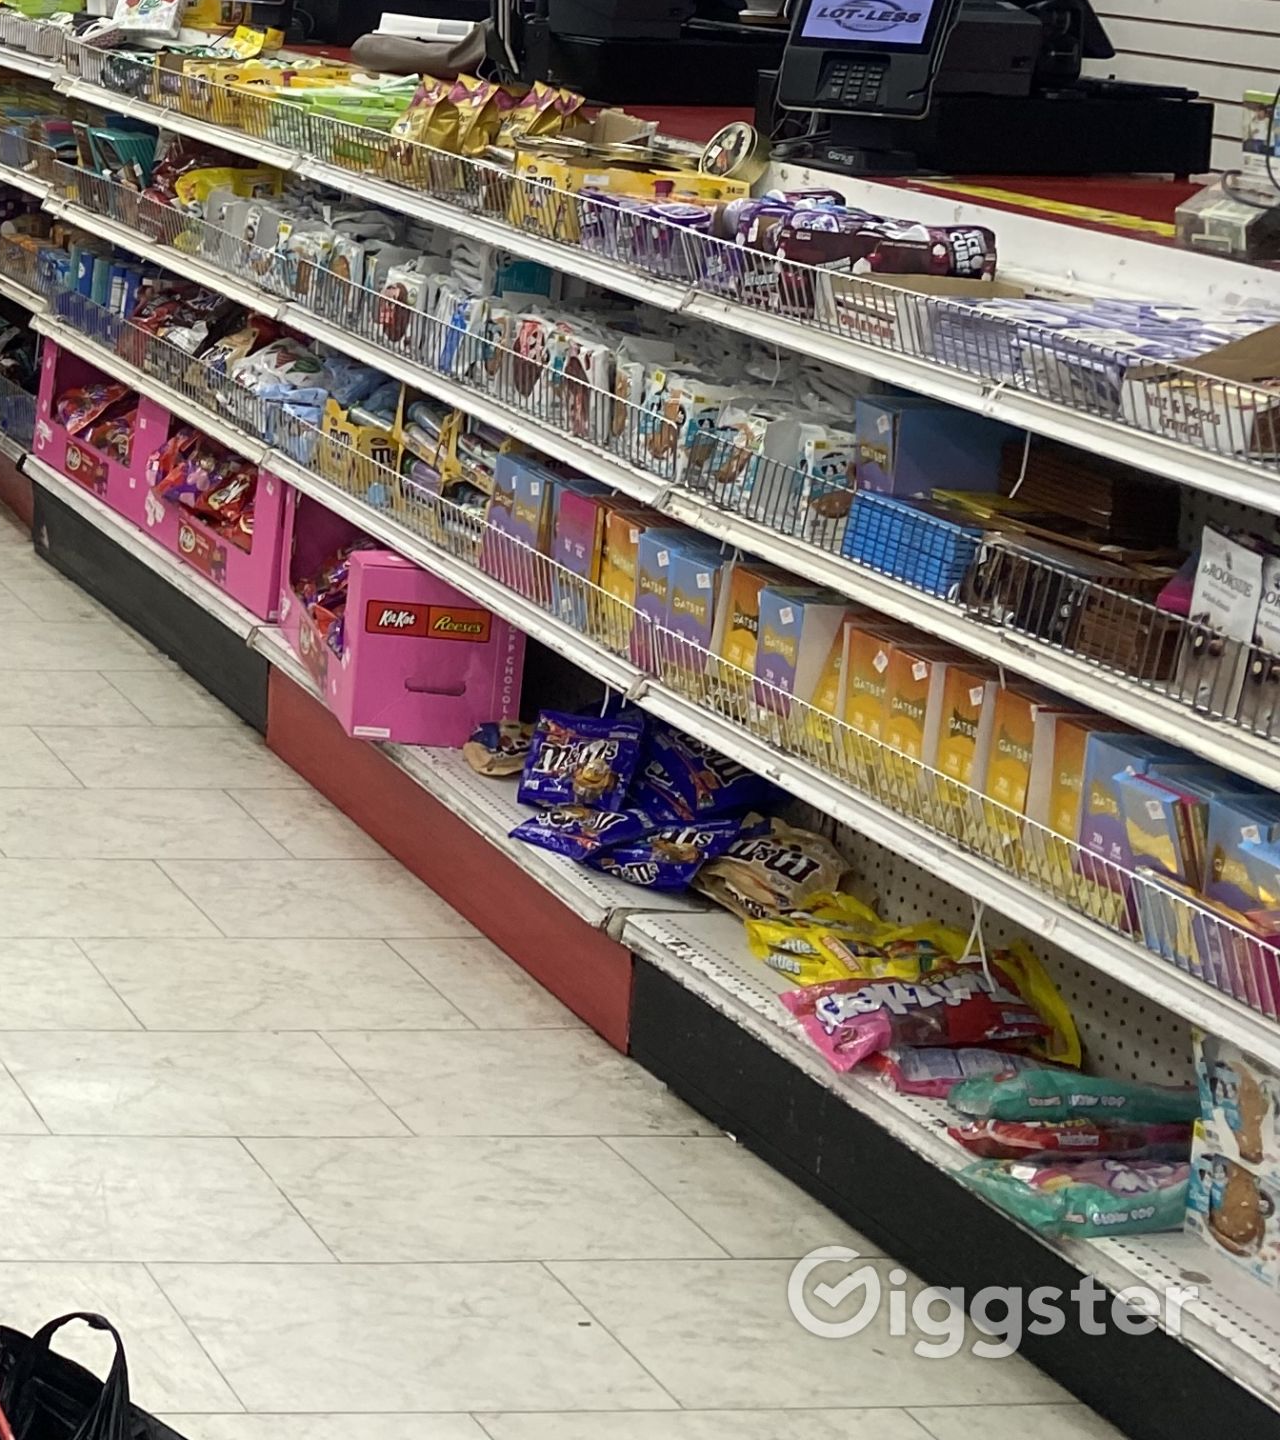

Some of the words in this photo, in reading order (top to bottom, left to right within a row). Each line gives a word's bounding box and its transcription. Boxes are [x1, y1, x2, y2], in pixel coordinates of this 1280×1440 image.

[817, 7, 922, 23] LOT-LESS
[673, 597, 705, 617] GATSBY
[733, 611, 758, 632] GATSB
[853, 676, 887, 697] GATSBY
[891, 697, 923, 718] GATSBY
[949, 716, 978, 738] GATSB
[1130, 1206, 1155, 1220] POP
